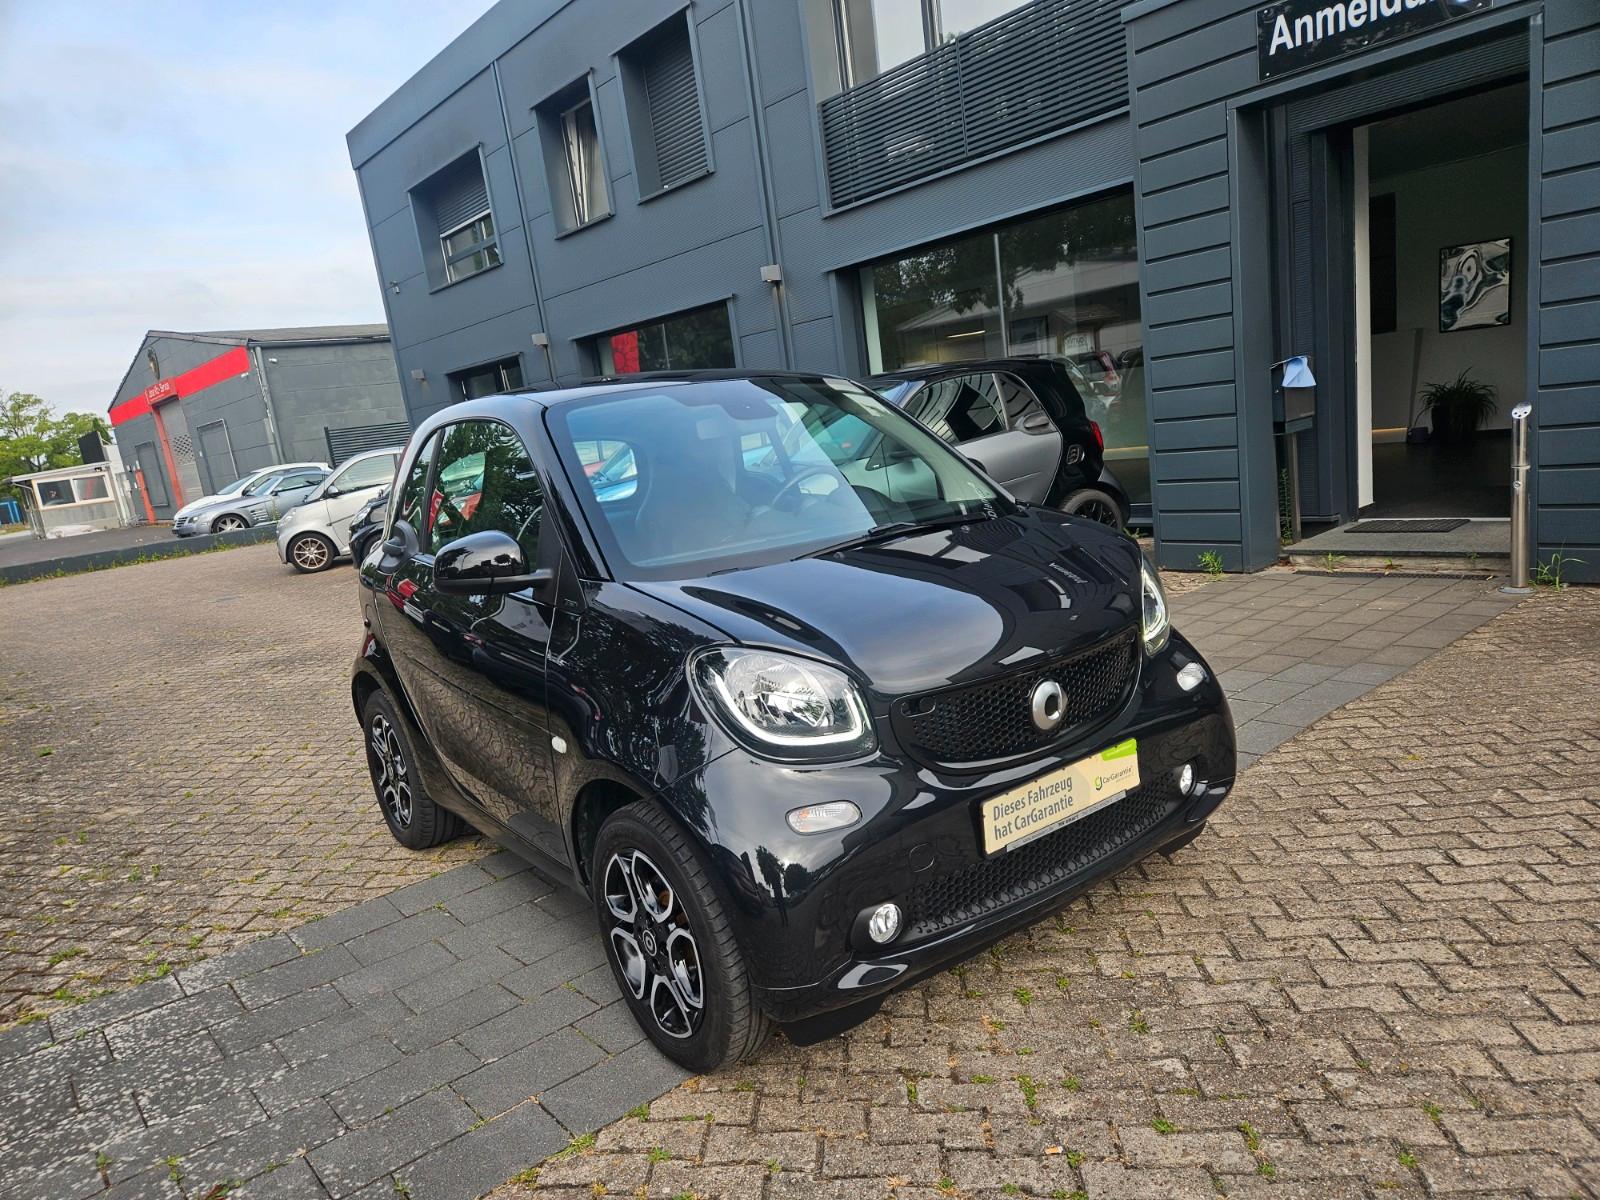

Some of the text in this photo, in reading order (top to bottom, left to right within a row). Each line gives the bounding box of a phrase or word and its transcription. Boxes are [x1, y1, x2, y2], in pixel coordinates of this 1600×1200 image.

[993, 796, 1026, 821] Dieses
[1028, 776, 1073, 806] Fahrzeug
[994, 820, 1013, 841] hat
[1014, 794, 1074, 831] CarGarantie
